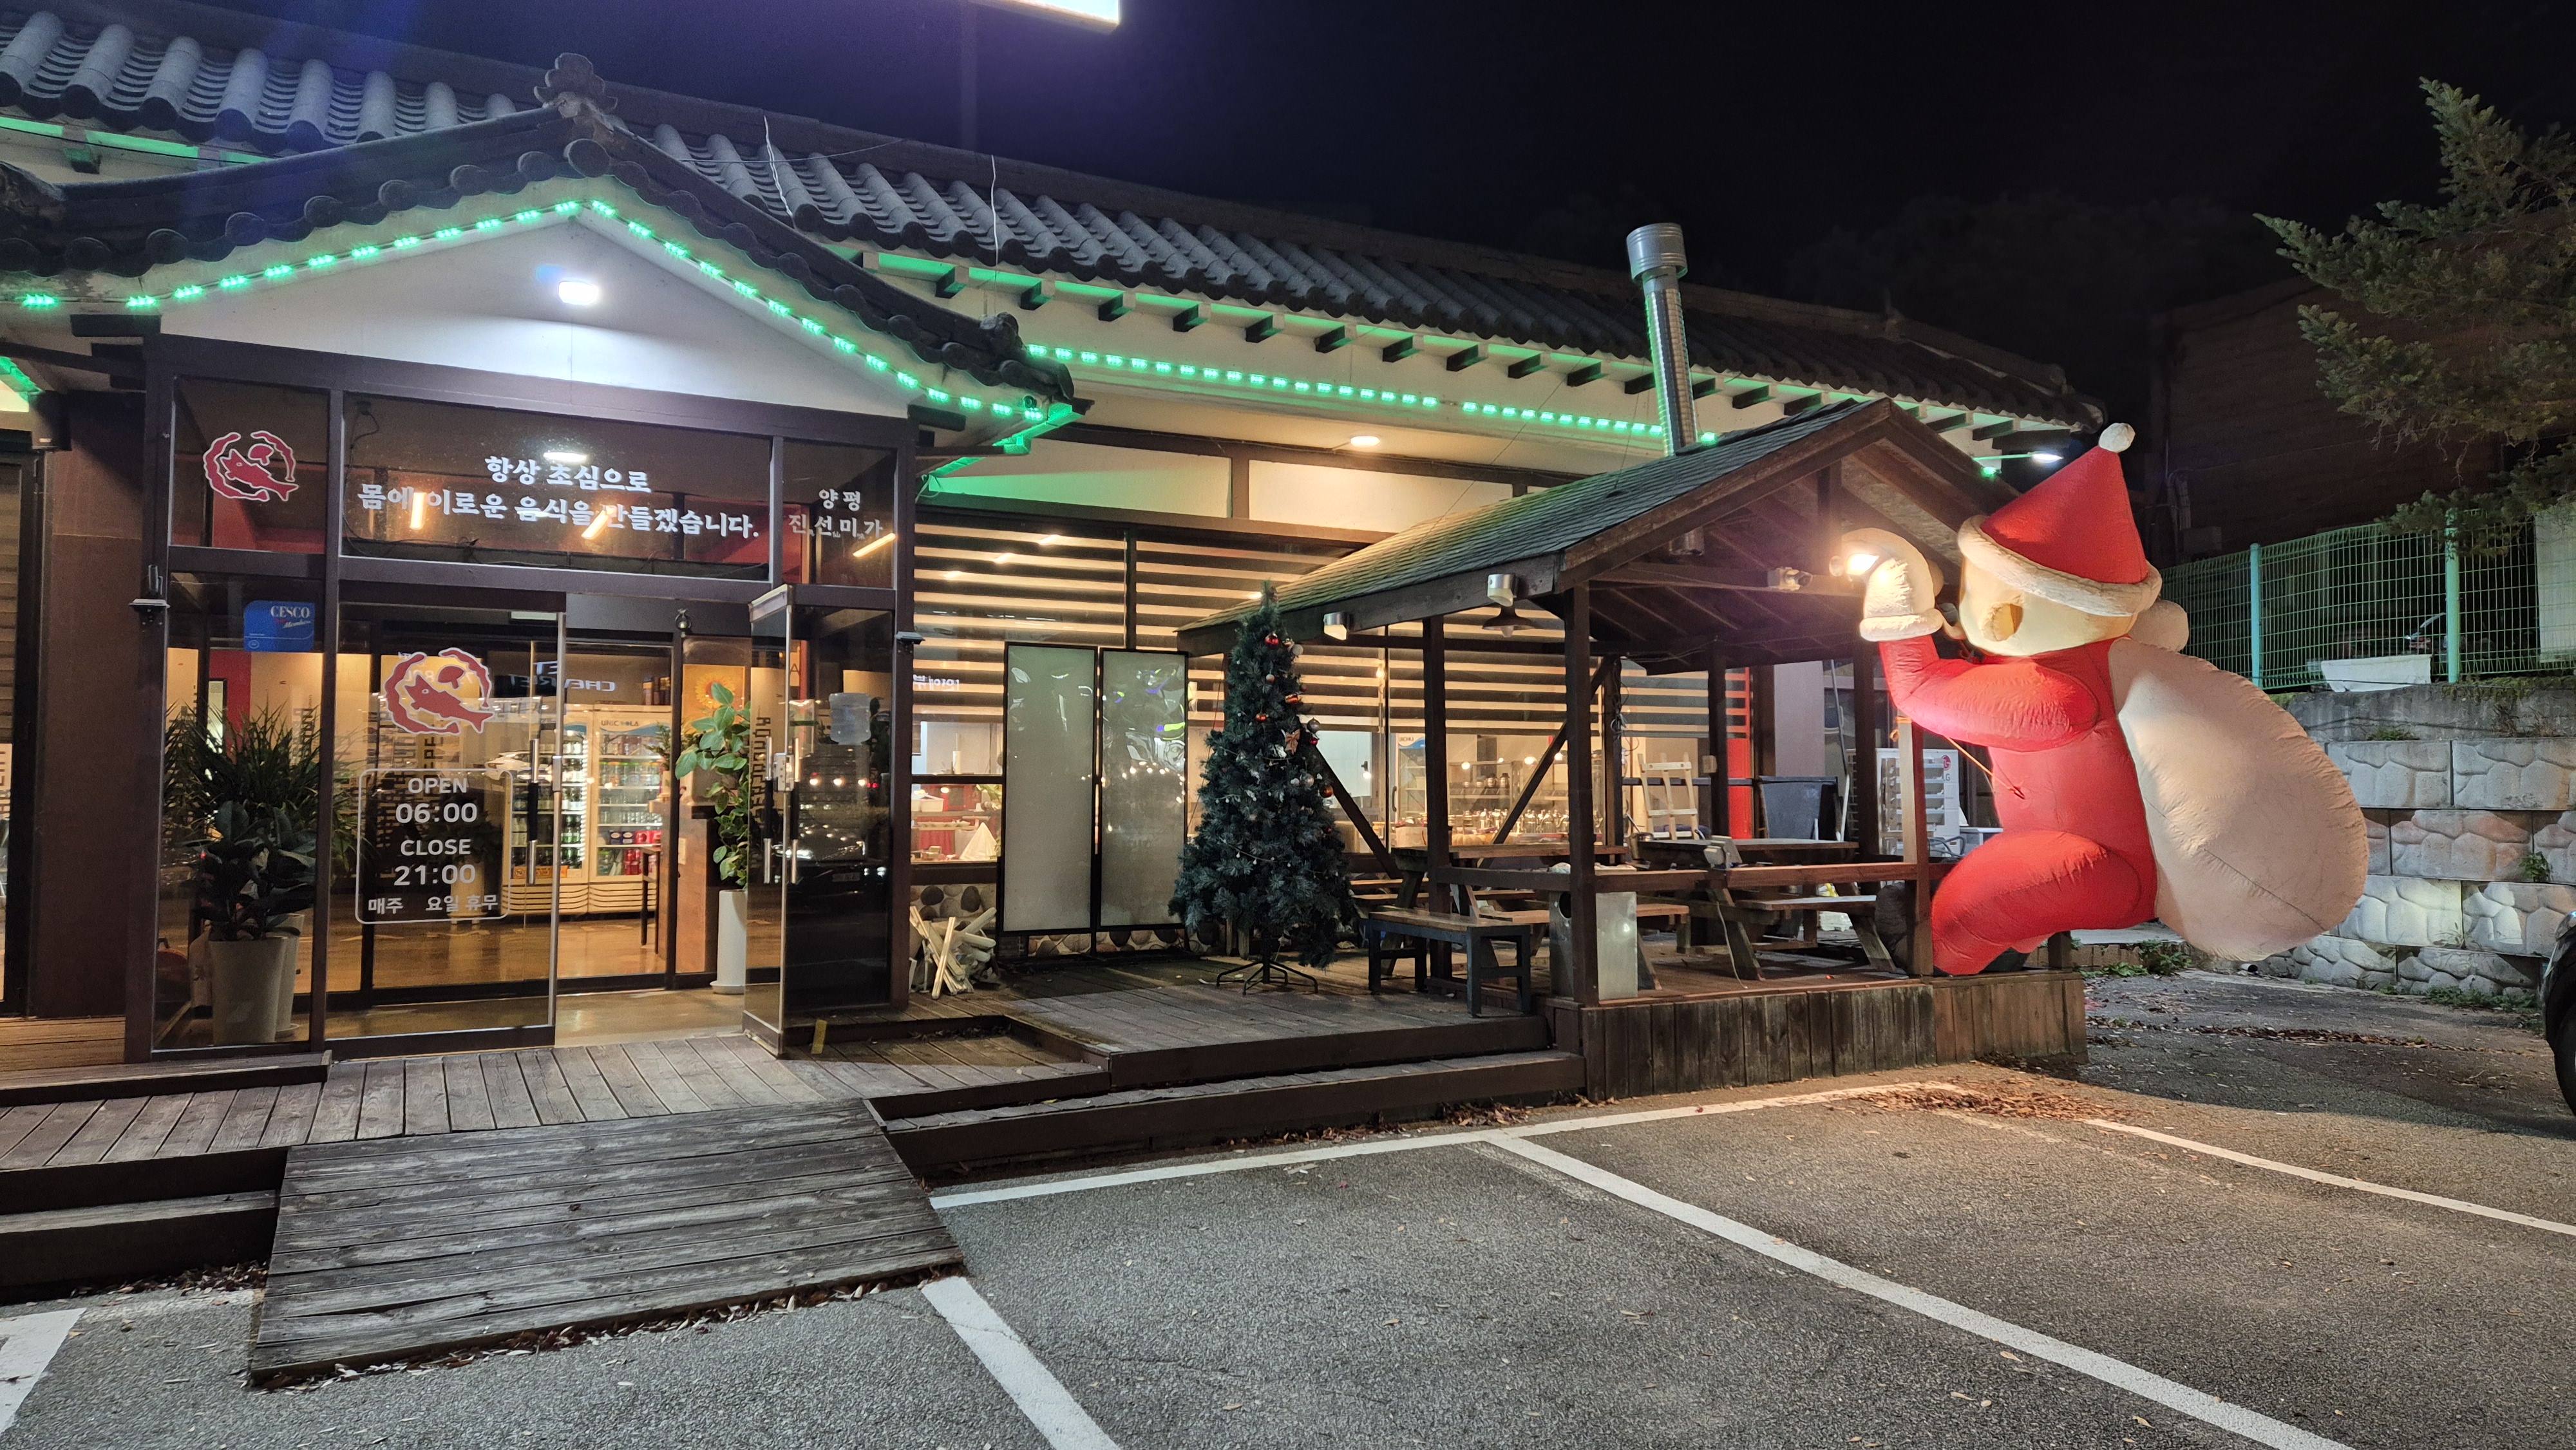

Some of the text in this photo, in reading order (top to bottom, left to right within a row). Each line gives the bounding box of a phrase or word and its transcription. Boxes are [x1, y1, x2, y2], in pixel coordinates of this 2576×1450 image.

[485, 455, 652, 493] 항상 초심으로
[819, 489, 861, 512] 양평
[357, 484, 759, 539] 몸에 이로운 음식을 만들겠습니다.
[270, 606, 310, 618] CESCO
[408, 778, 467, 794] OPEN
[395, 803, 477, 824] 06:00
[400, 839, 471, 856] CLOSE
[394, 864, 476, 886] 21:00
[368, 894, 498, 914] 매주 요일 휴무
